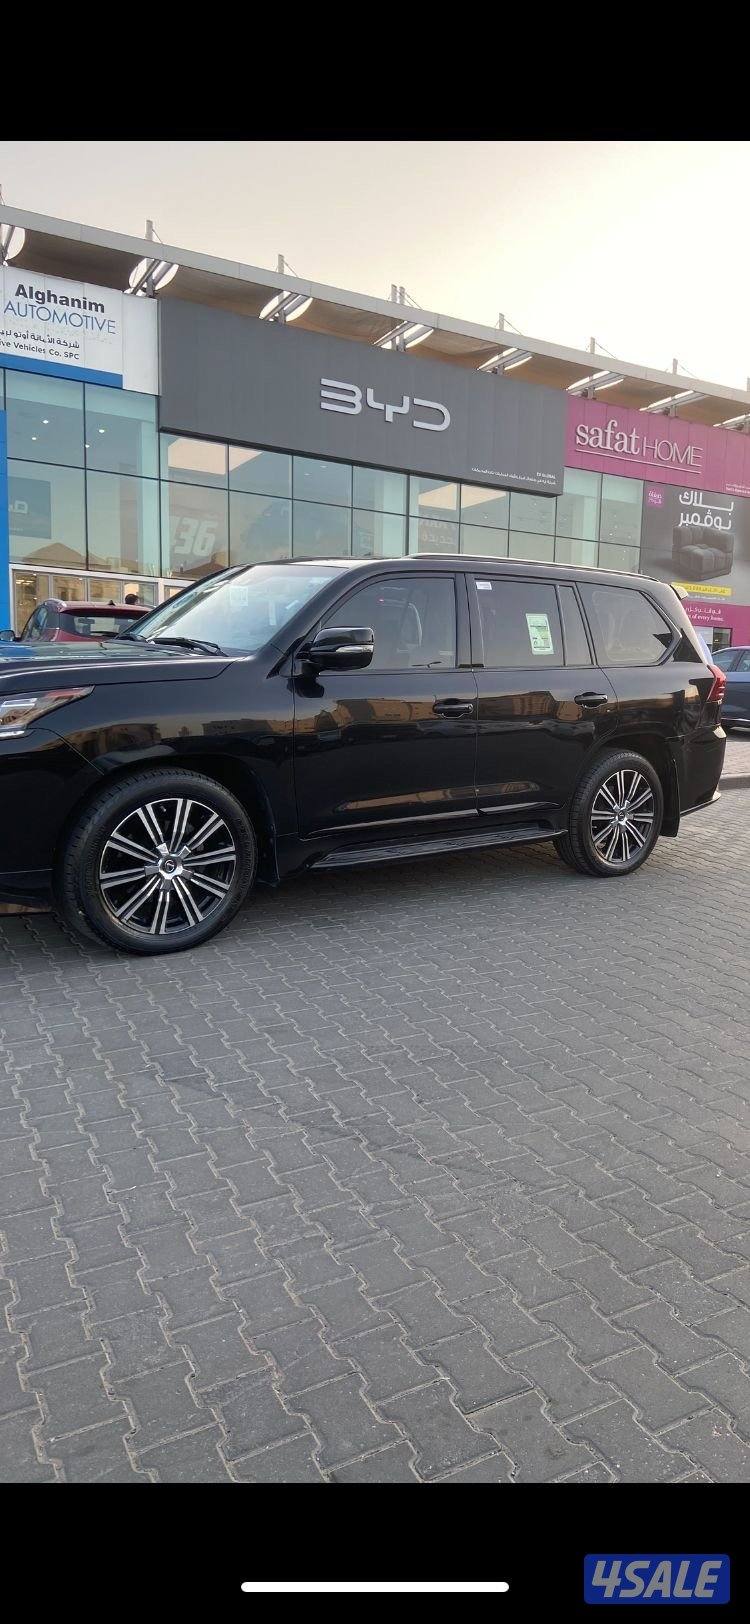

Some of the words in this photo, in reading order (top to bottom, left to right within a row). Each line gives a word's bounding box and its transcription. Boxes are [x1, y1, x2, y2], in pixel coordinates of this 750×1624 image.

[14, 283, 105, 314] Alghanim
[3, 300, 117, 335] AUTOMOTIVE
[13, 342, 46, 354] Vehicles
[63, 351, 80, 360] SPC
[56, 337, 80, 349] شركة
[320, 378, 451, 432] BYD
[576, 419, 641, 455] safat
[642, 436, 703, 467] HOME
